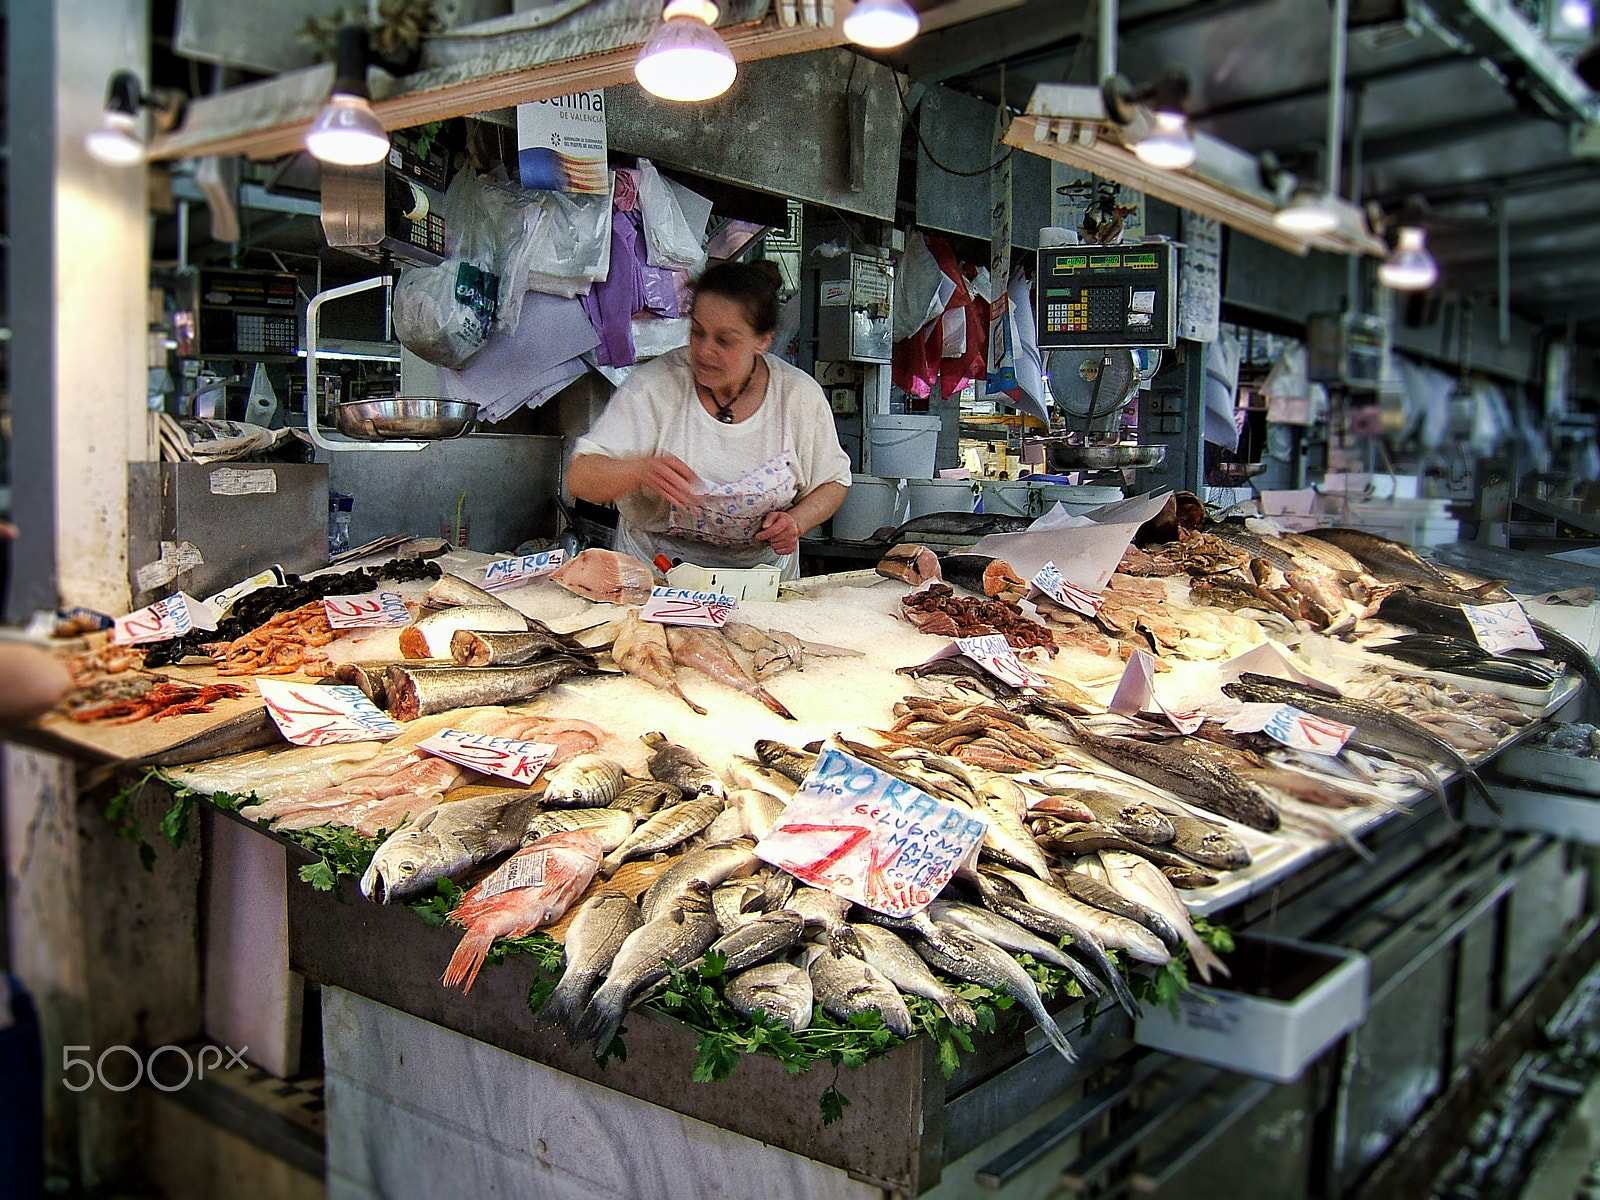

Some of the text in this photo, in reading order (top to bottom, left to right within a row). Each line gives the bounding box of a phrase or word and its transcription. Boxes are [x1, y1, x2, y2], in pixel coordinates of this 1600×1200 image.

[560, 111, 604, 123] DE VALENCIA
[486, 552, 549, 578] MERO
[816, 749, 984, 845] DORADA
